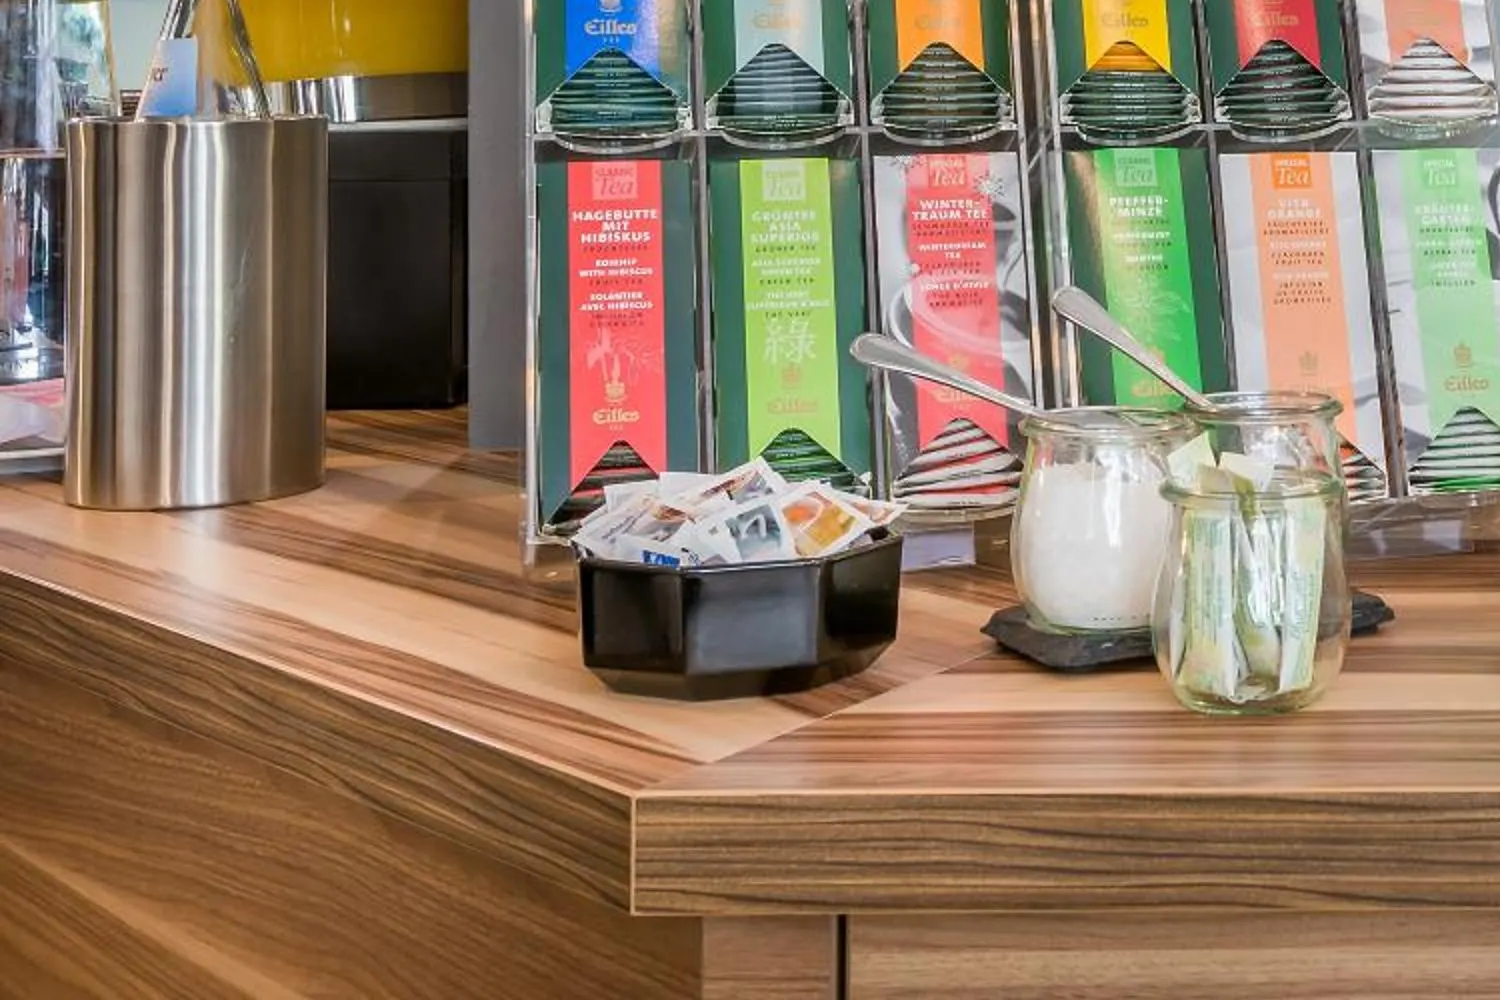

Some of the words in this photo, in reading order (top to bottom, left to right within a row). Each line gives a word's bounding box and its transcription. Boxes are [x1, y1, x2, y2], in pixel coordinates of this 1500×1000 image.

[584, 18, 637, 35] Eilles
[1277, 167, 1309, 185] Tea
[600, 178, 634, 196] Tea
[919, 199, 981, 210] WINTER-
[573, 209, 658, 221] HAGEBUTTE
[912, 210, 961, 221] TRAUM
[965, 209, 989, 219] TEE
[1116, 207, 1163, 217] MINZE
[1267, 208, 1321, 219] ORANGE
[601, 221, 630, 231] MIT
[769, 221, 802, 231] ASIA
[580, 232, 651, 244] HIBISKUS
[595, 259, 638, 267] ROSEHIP
[608, 268, 654, 276] HIBISCUS
[608, 302, 654, 310] HIBISCUS
[1443, 375, 1490, 392] Eilles
[593, 408, 640, 424] Eilles
